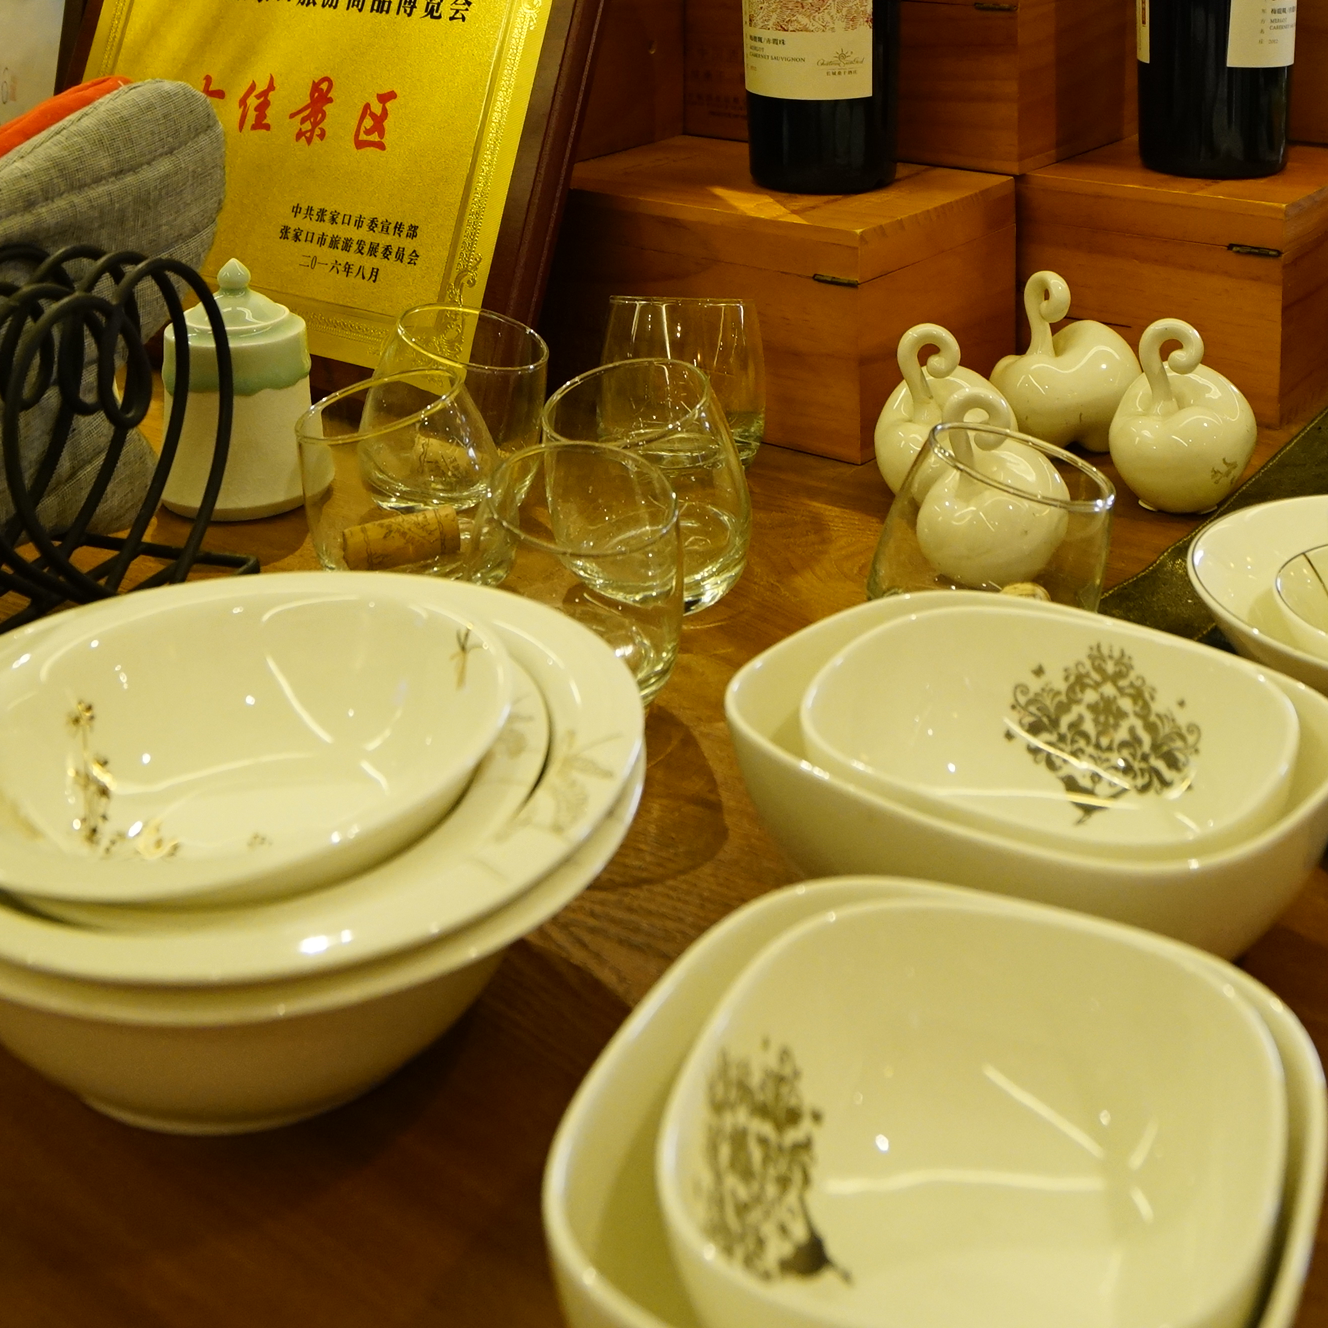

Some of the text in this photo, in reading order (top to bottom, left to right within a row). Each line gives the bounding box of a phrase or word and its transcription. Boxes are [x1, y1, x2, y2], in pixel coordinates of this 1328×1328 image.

[291, 203, 420, 240] 中共张家口市委宣传部
[279, 225, 420, 266] 张家口市旅游发展委员会
